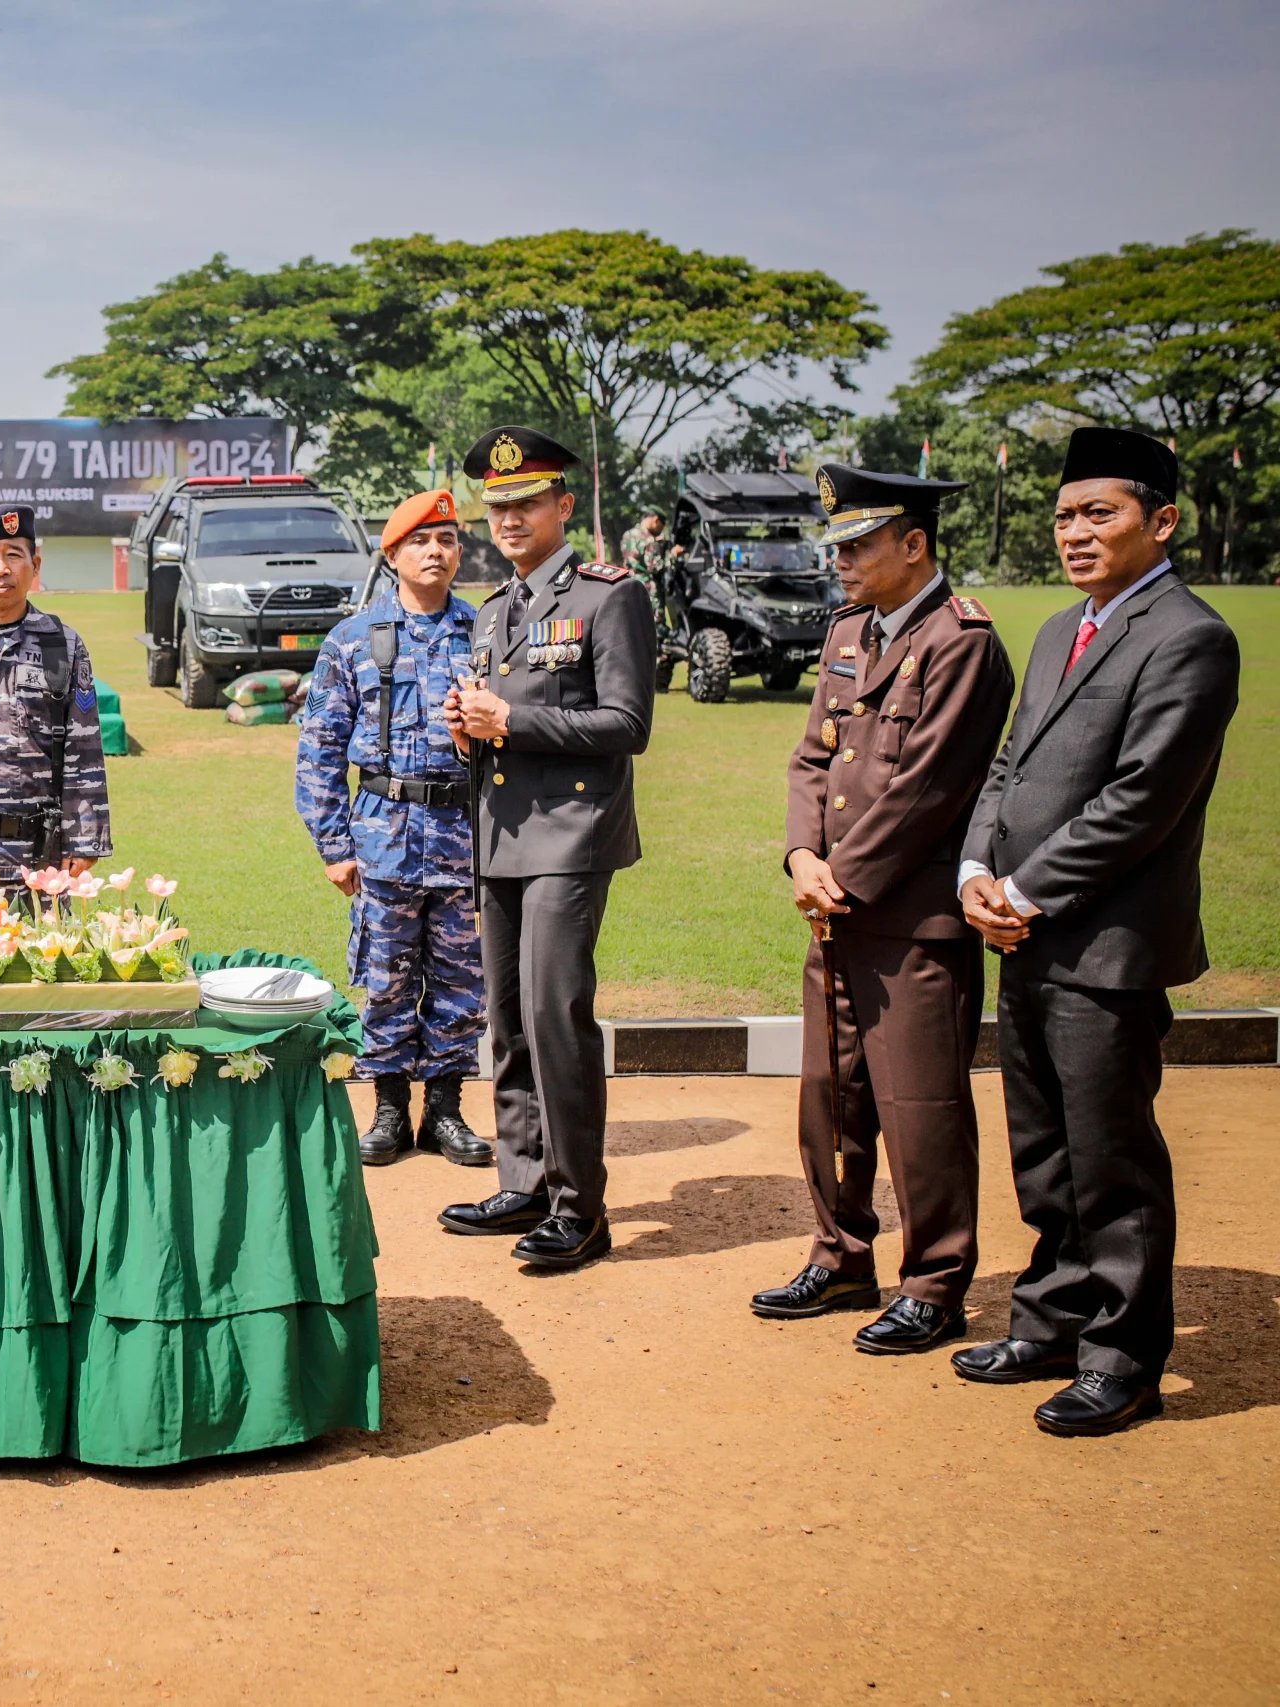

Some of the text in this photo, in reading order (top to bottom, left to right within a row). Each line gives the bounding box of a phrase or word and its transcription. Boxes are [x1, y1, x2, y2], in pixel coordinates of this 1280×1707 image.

[15, 440, 57, 480] 79
[68, 440, 176, 480] TAHUN
[187, 439, 275, 478] 2024
[35, 487, 95, 502] SUKSESI
[25, 651, 42, 663] TN
